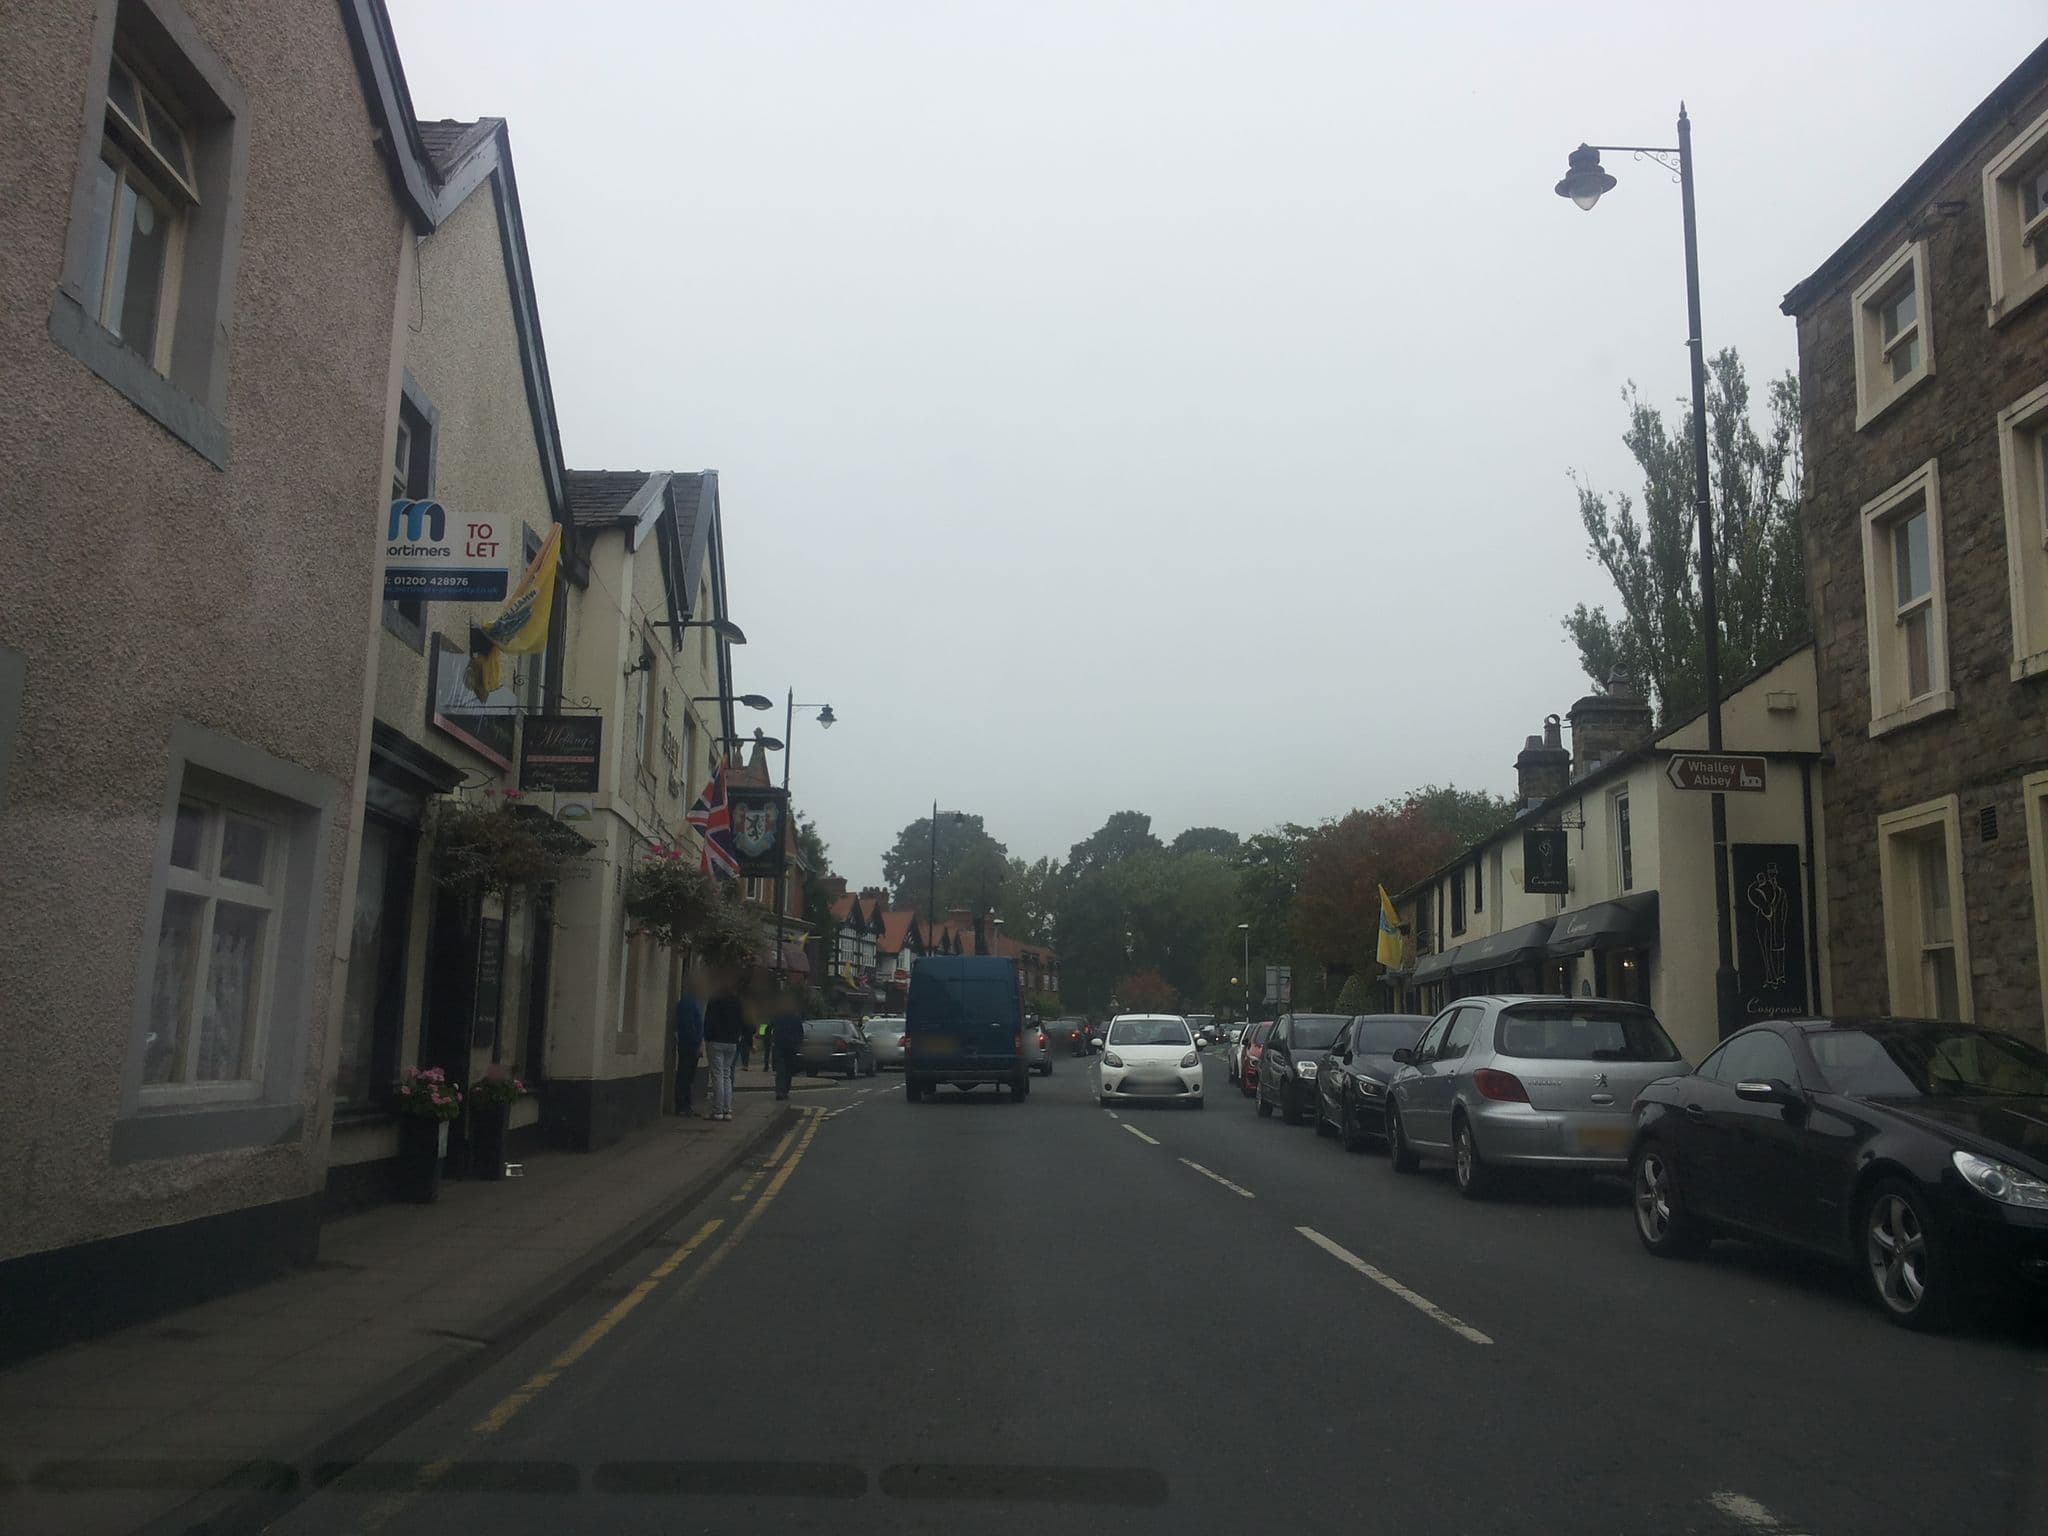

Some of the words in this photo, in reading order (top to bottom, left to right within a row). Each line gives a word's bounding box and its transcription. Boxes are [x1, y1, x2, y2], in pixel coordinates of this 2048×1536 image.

[467, 523, 493, 540] TO
[466, 541, 500, 558] LET
[393, 576, 428, 586] 01200
[429, 577, 469, 587] 428976
[1687, 760, 1736, 775] Whalley
[1693, 774, 1731, 788] Abbey
[1746, 996, 1802, 1017] Cosgroves
